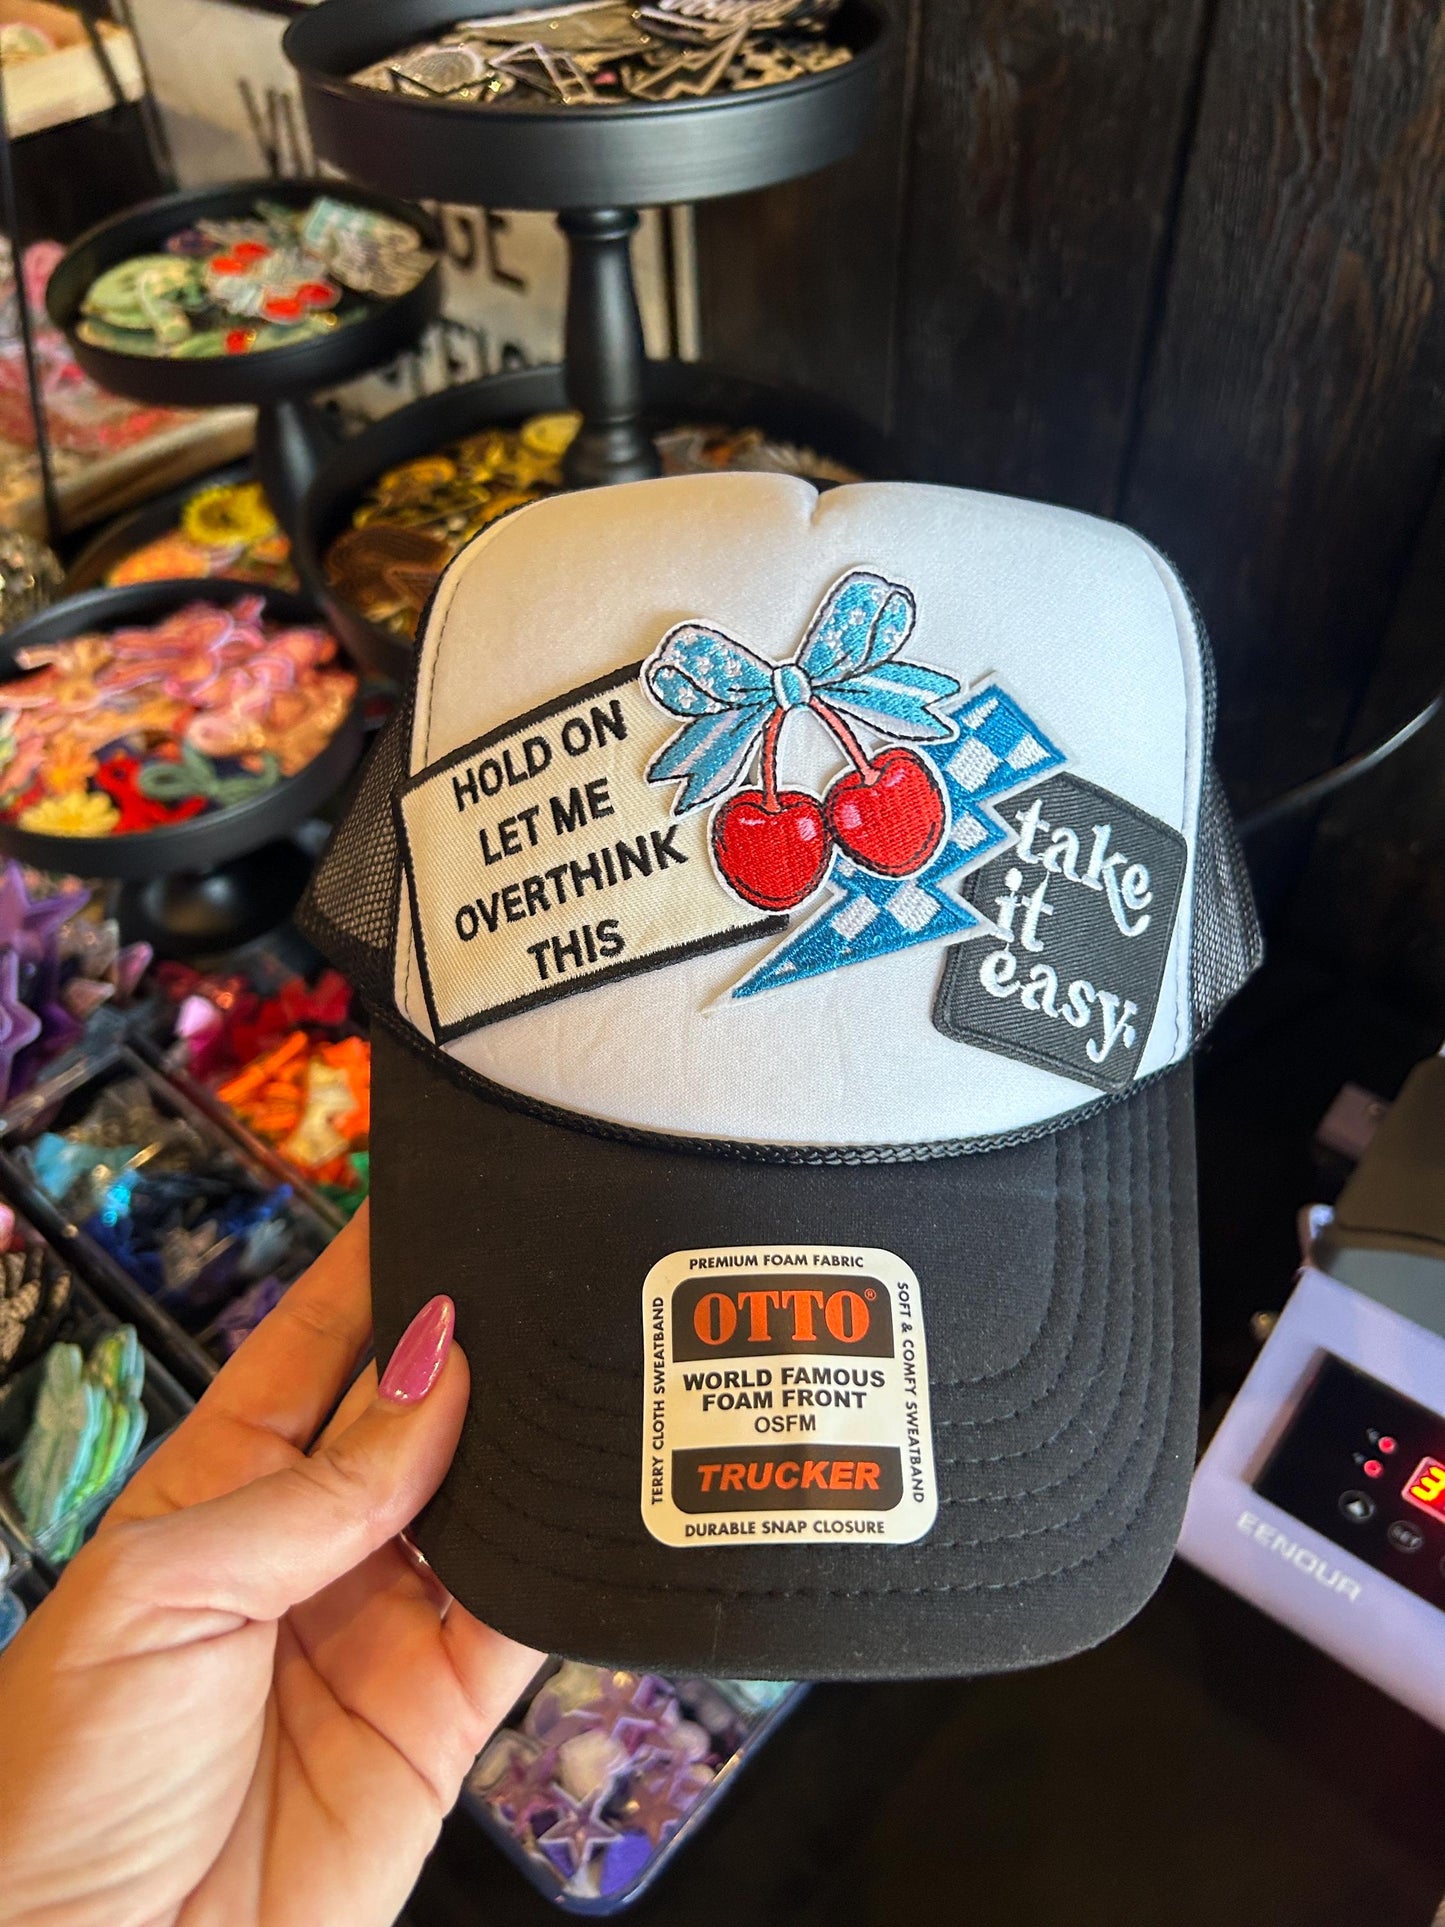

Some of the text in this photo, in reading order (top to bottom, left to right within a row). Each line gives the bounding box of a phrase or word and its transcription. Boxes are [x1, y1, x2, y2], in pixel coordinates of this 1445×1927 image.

[452, 699, 629, 812] HOLD ON
[478, 777, 616, 867] LET ME
[454, 823, 690, 943] OVERTHINK
[1014, 798, 1154, 938] take
[994, 867, 1055, 952] it
[526, 918, 627, 981] THIS
[688, 1253, 865, 1271] PREMIUM FOAM FABRIC
[650, 1296, 666, 1506] TERRY CLOTH SWEATBAND
[683, 1366, 886, 1391] WORLD FAMOUS
[701, 1388, 867, 1412] FOAM FRONT
[896, 1281, 925, 1504] SOFT & COMFY SWEATBAND
[753, 1413, 816, 1434] OSFM
[697, 1460, 881, 1494] TRUCKER
[684, 1519, 886, 1538] DURABLE SNAP CLOSURE
